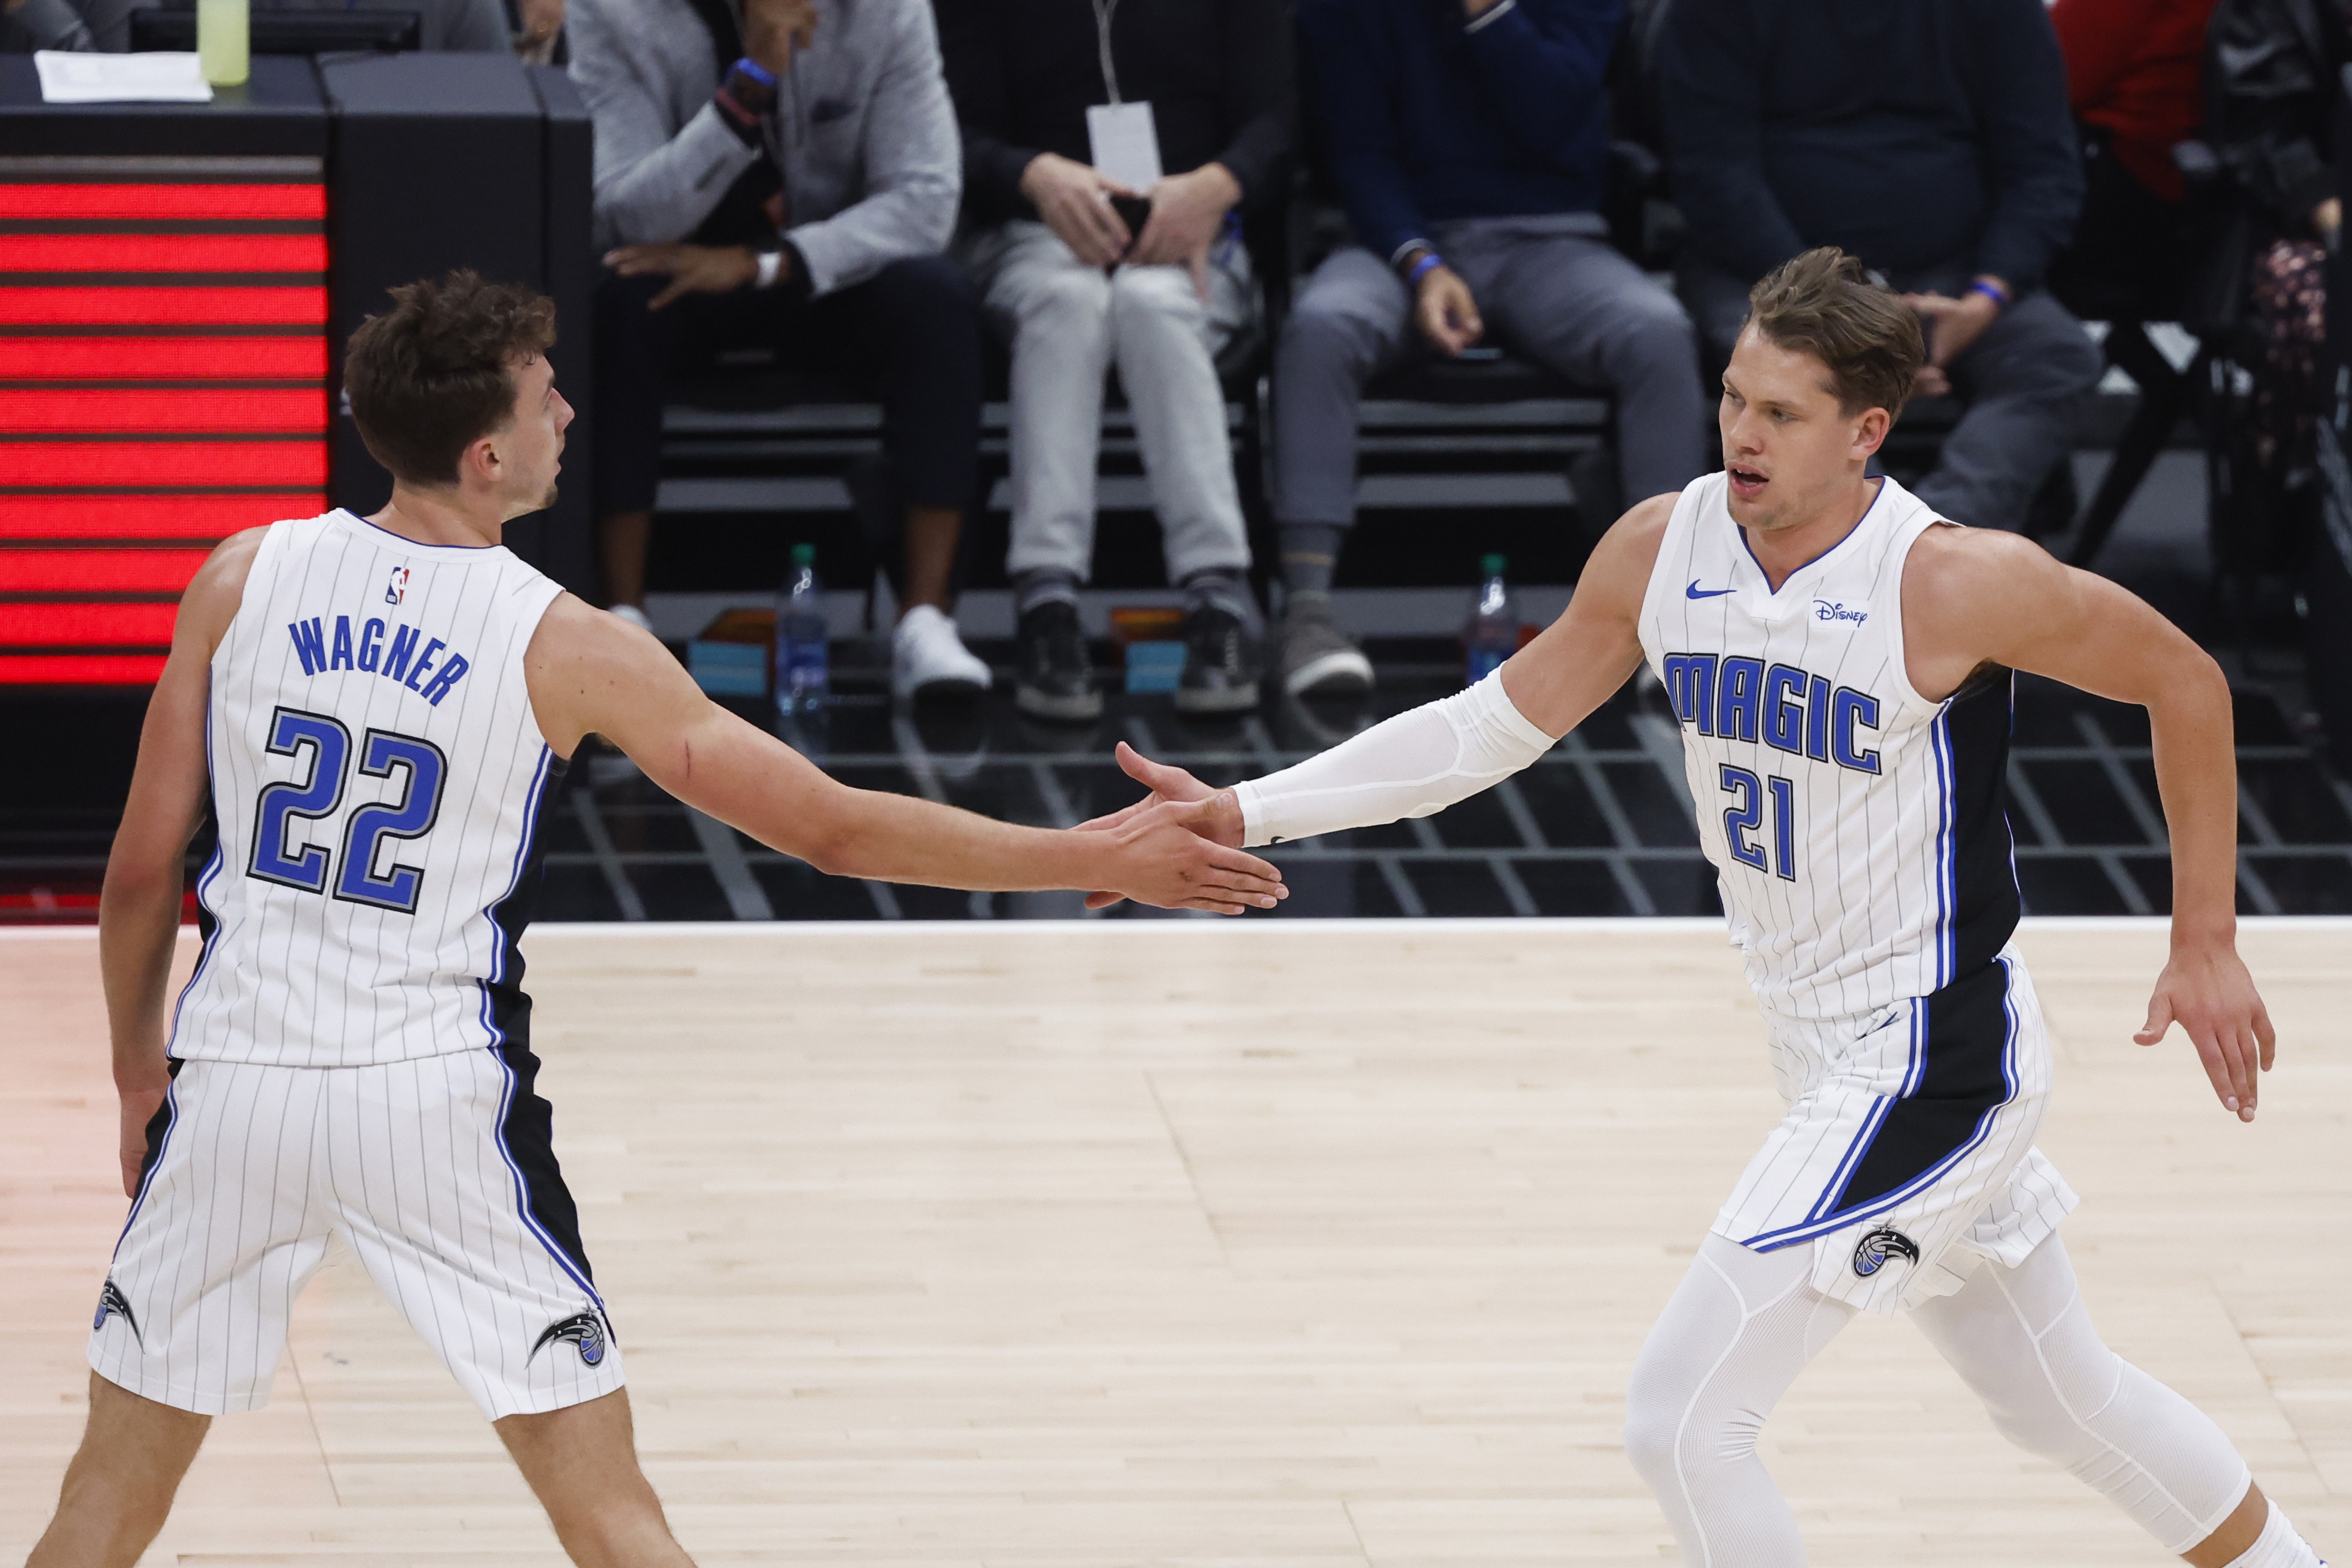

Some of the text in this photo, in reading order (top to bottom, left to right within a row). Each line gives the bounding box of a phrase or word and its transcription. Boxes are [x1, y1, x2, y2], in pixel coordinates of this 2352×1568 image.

[287, 615, 469, 707] WAGNER
[1663, 652, 1882, 776] MAGIC
[245, 705, 448, 916] 22
[1718, 763, 1796, 882] 21
